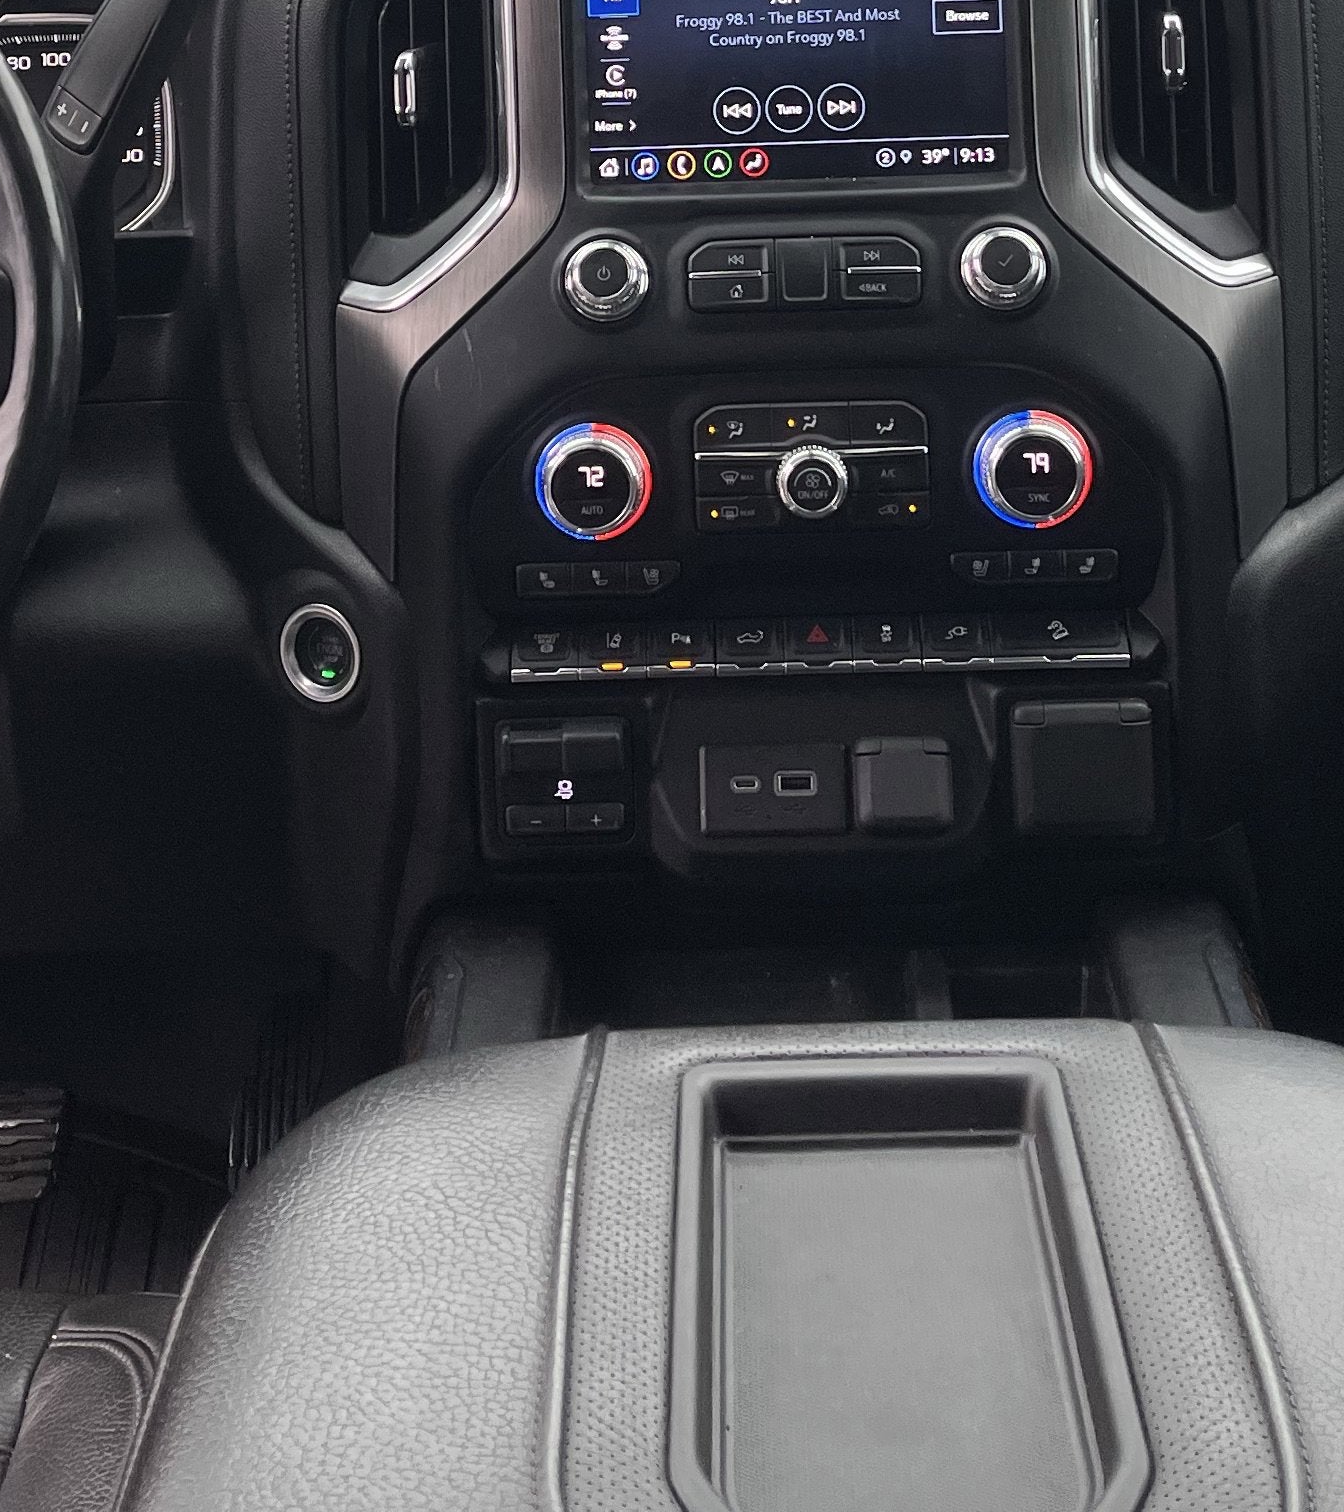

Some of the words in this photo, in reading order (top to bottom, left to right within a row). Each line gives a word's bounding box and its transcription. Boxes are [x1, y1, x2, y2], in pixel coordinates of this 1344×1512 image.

[675, 14, 723, 31] Froggy
[725, 13, 754, 26] 98.1
[767, 11, 794, 24] The
[797, 9, 833, 23] BEST
[835, 8, 862, 22] And
[865, 8, 901, 22] Most
[945, 9, 990, 22] Browse
[709, 33, 764, 49] Country
[766, 34, 784, 44] on
[786, 30, 834, 47] Froggy
[837, 29, 866, 42] 98.1
[40, 52, 71, 66] 100
[775, 103, 803, 116] Tune
[594, 121, 623, 133] More
[959, 147, 995, 163] 9:13
[865, 282, 887, 293] BACK
[1023, 452, 1050, 474] 79
[578, 466, 605, 488] 72
[797, 490, 829, 500] ON/OFF
[1028, 493, 1050, 503] SYNC
[581, 505, 604, 516] AUTO
